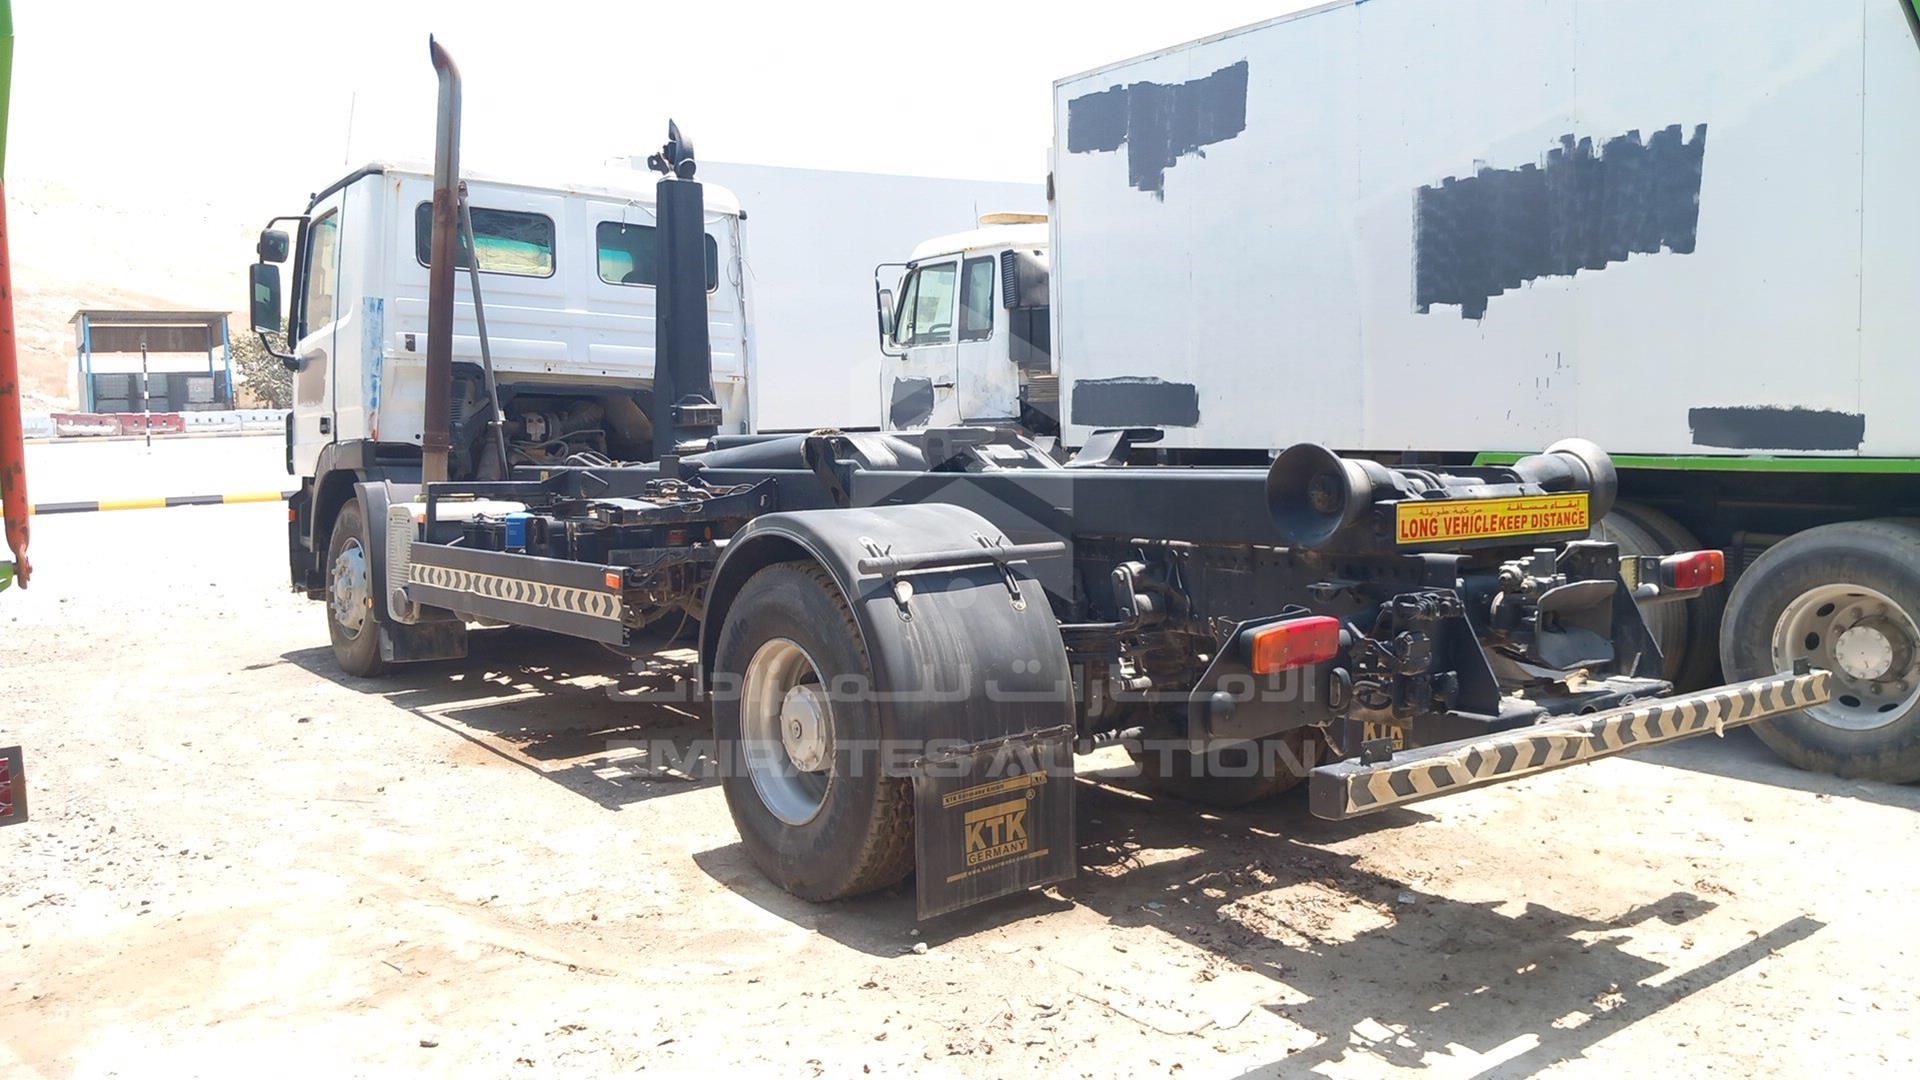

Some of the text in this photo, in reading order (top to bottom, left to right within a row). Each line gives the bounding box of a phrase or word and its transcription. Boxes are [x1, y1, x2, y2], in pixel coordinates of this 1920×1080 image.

[1401, 514, 1498, 538] LONG VEHICLE
[1499, 510, 1585, 531] KEEP DISTANCE
[966, 810, 1026, 854] KTK
[968, 841, 1025, 864] GERMANY
